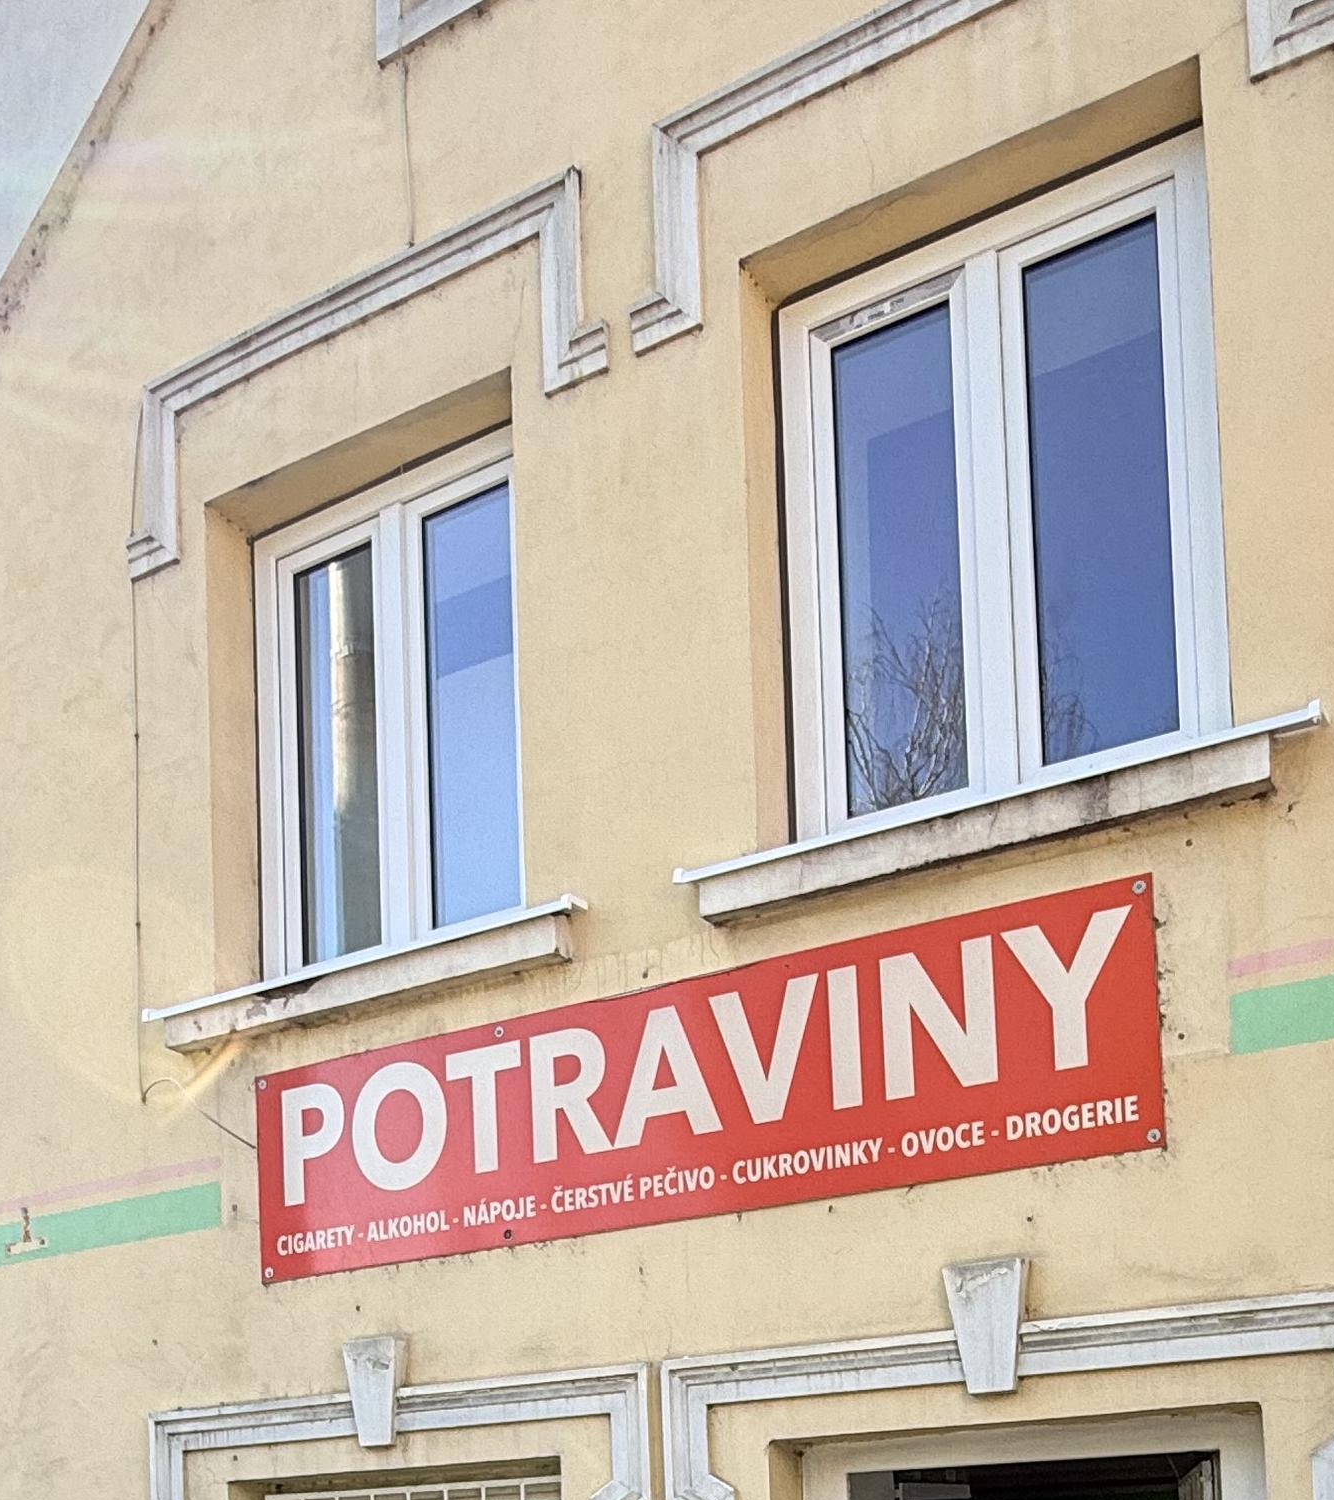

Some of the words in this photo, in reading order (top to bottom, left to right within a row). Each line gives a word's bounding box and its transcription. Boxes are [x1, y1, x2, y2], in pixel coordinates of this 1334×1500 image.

[280, 903, 1134, 1208] POTRAVINY
[276, 1224, 356, 1257] CIGARETY
[366, 1211, 451, 1242] ALKOHOL
[463, 1195, 538, 1228] NÁPOJE
[551, 1173, 635, 1215] ČERSTVÉ
[639, 1166, 715, 1199] PEČIVO
[732, 1137, 883, 1184] CUKROVINKY
[901, 1120, 985, 1158] OVOCE
[1005, 1095, 1140, 1141] DROGERIE
